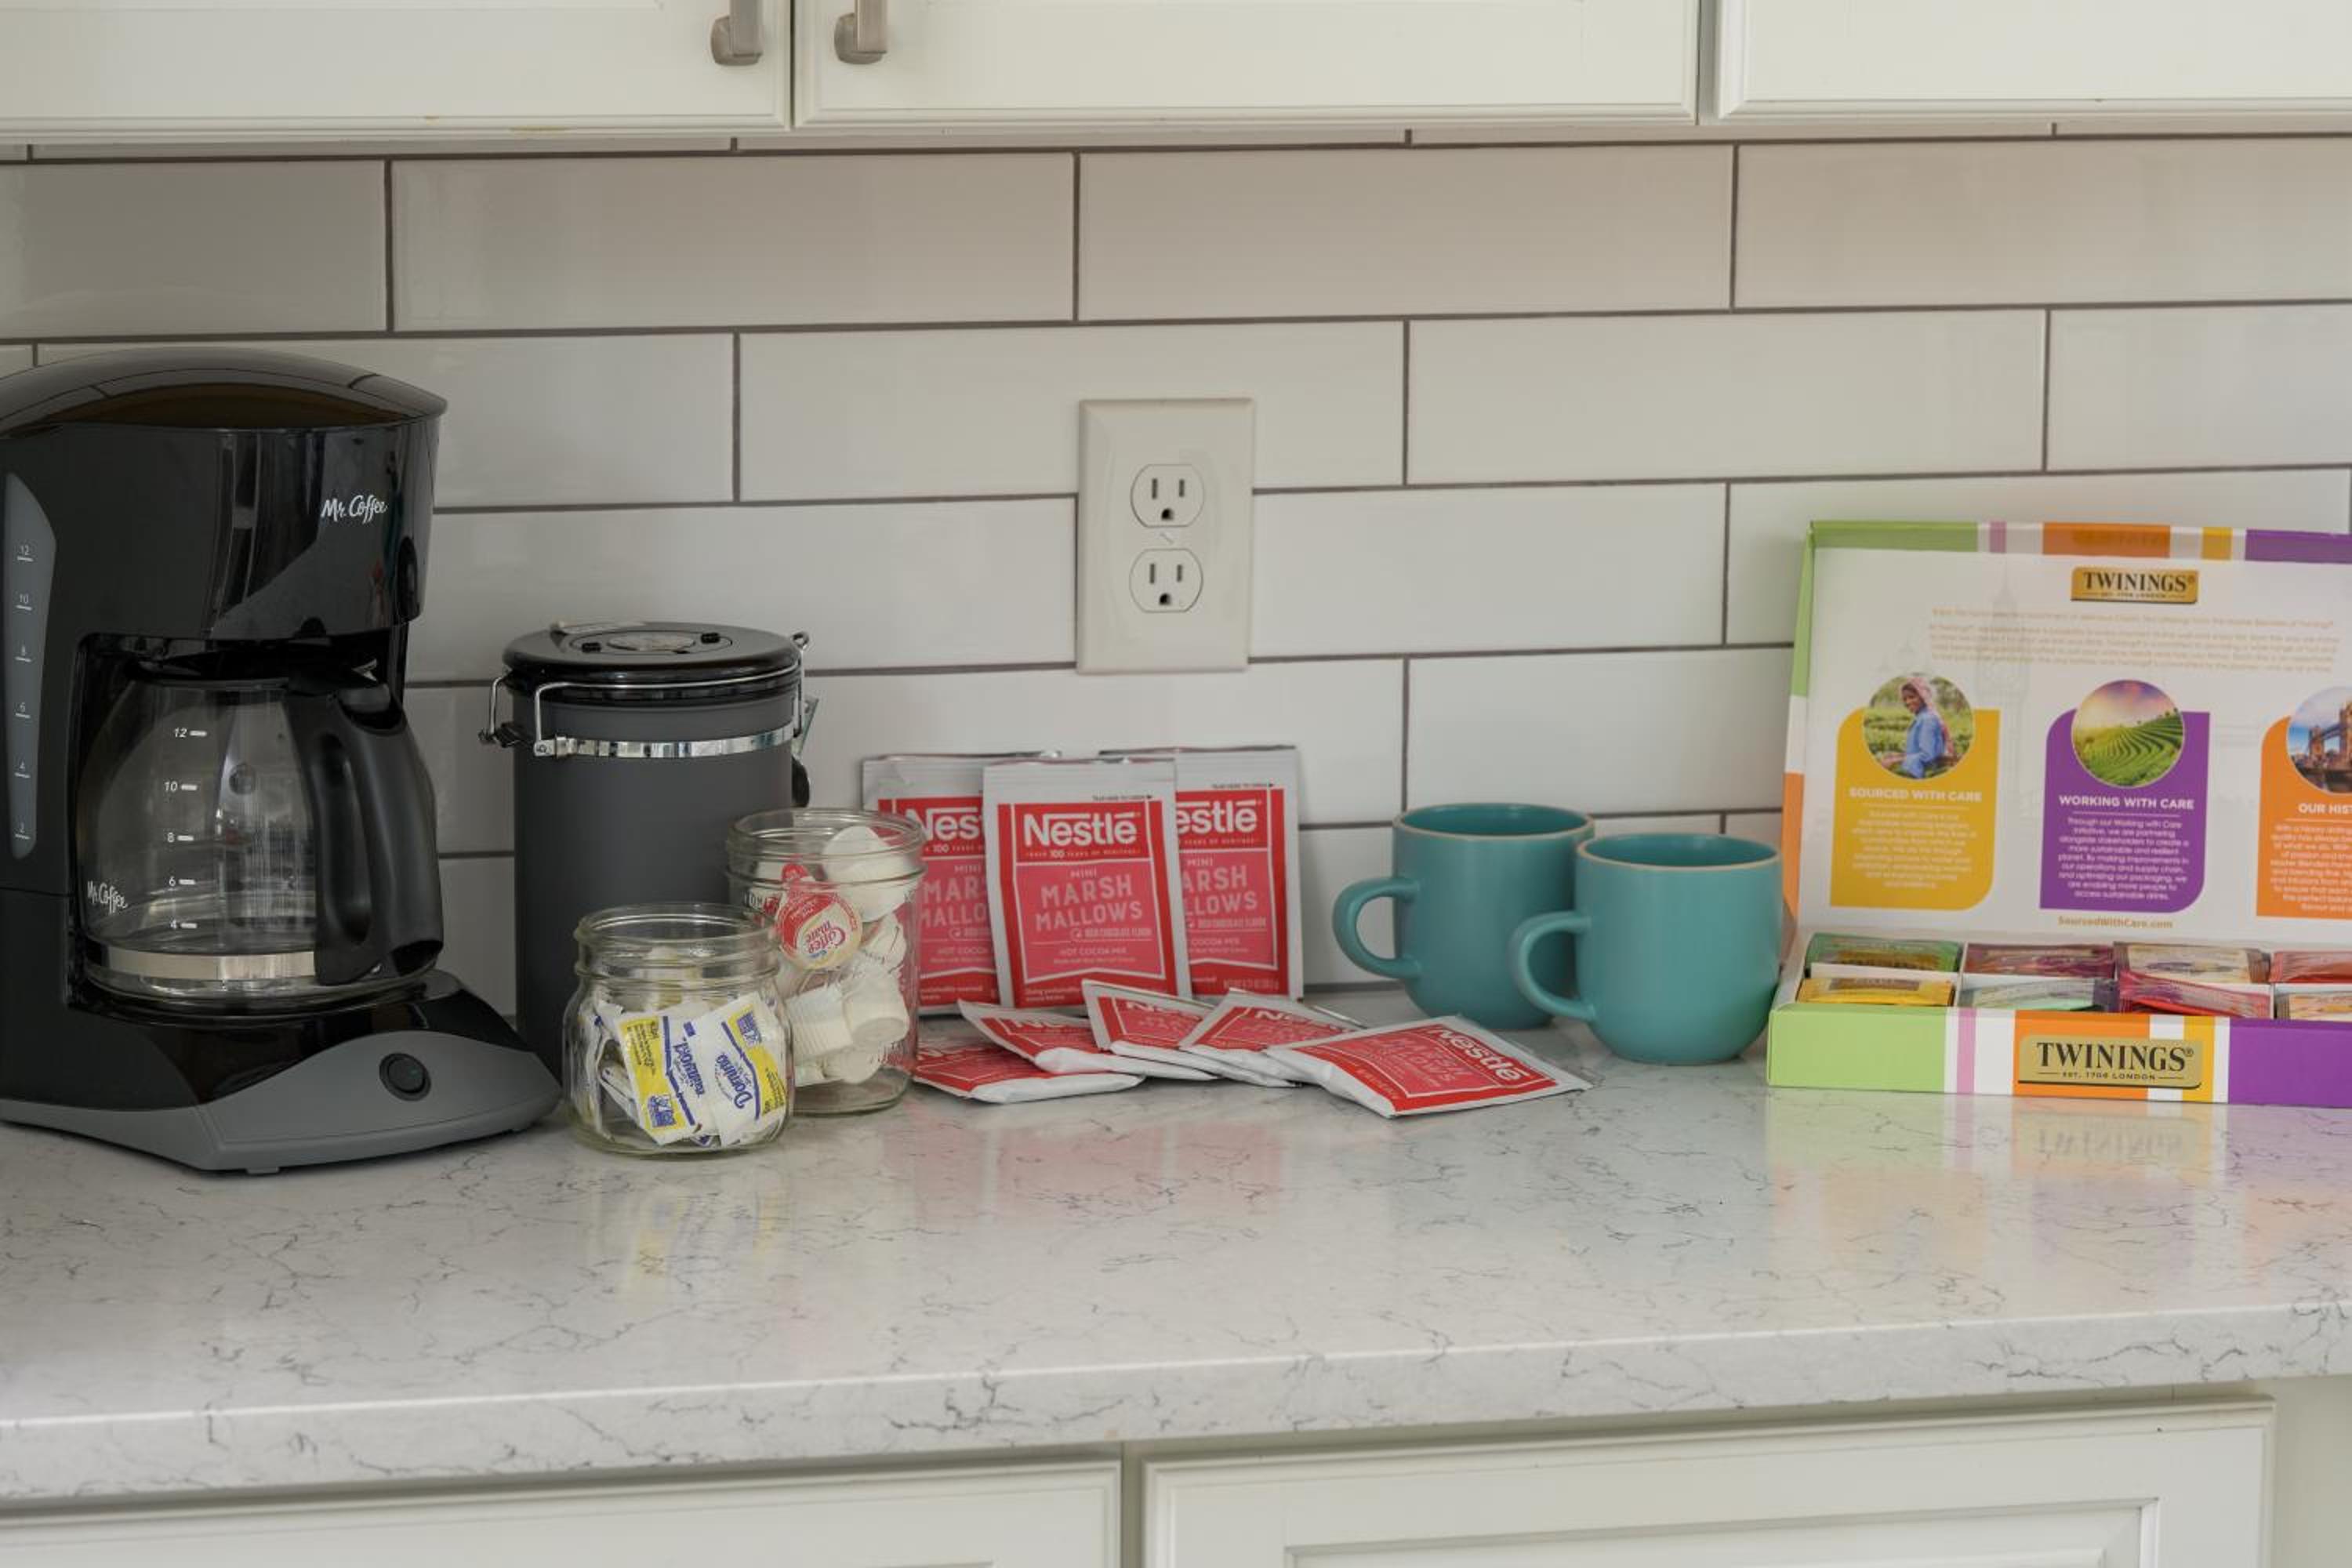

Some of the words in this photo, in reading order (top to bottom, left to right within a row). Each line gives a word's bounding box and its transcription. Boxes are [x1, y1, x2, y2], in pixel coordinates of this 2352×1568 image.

[321, 498, 347, 523] Mr.
[349, 495, 388, 524] Coffee
[2084, 572, 2187, 592] TWININGS
[174, 728, 187, 738] 12
[165, 781, 178, 792] 10
[1849, 787, 1908, 799] SOURCED
[1911, 789, 1945, 800] WITH
[1948, 791, 1983, 803] CARE
[2058, 795, 2121, 807] WORKING
[2124, 797, 2157, 808] WITH
[2160, 799, 2194, 810] CARE
[2298, 803, 2326, 814] OUR
[906, 807, 982, 841] Nes
[1023, 812, 1138, 848] Nestlé
[167, 832, 174, 843] 8
[169, 877, 176, 887] 6
[924, 875, 987, 905] MAR
[1040, 874, 1133, 909] MARSH
[170, 920, 177, 929] 4
[1035, 901, 1143, 933] MALLOWS
[2037, 1042, 2186, 1072] TWININGS
[716, 1052, 753, 1110] Domino
